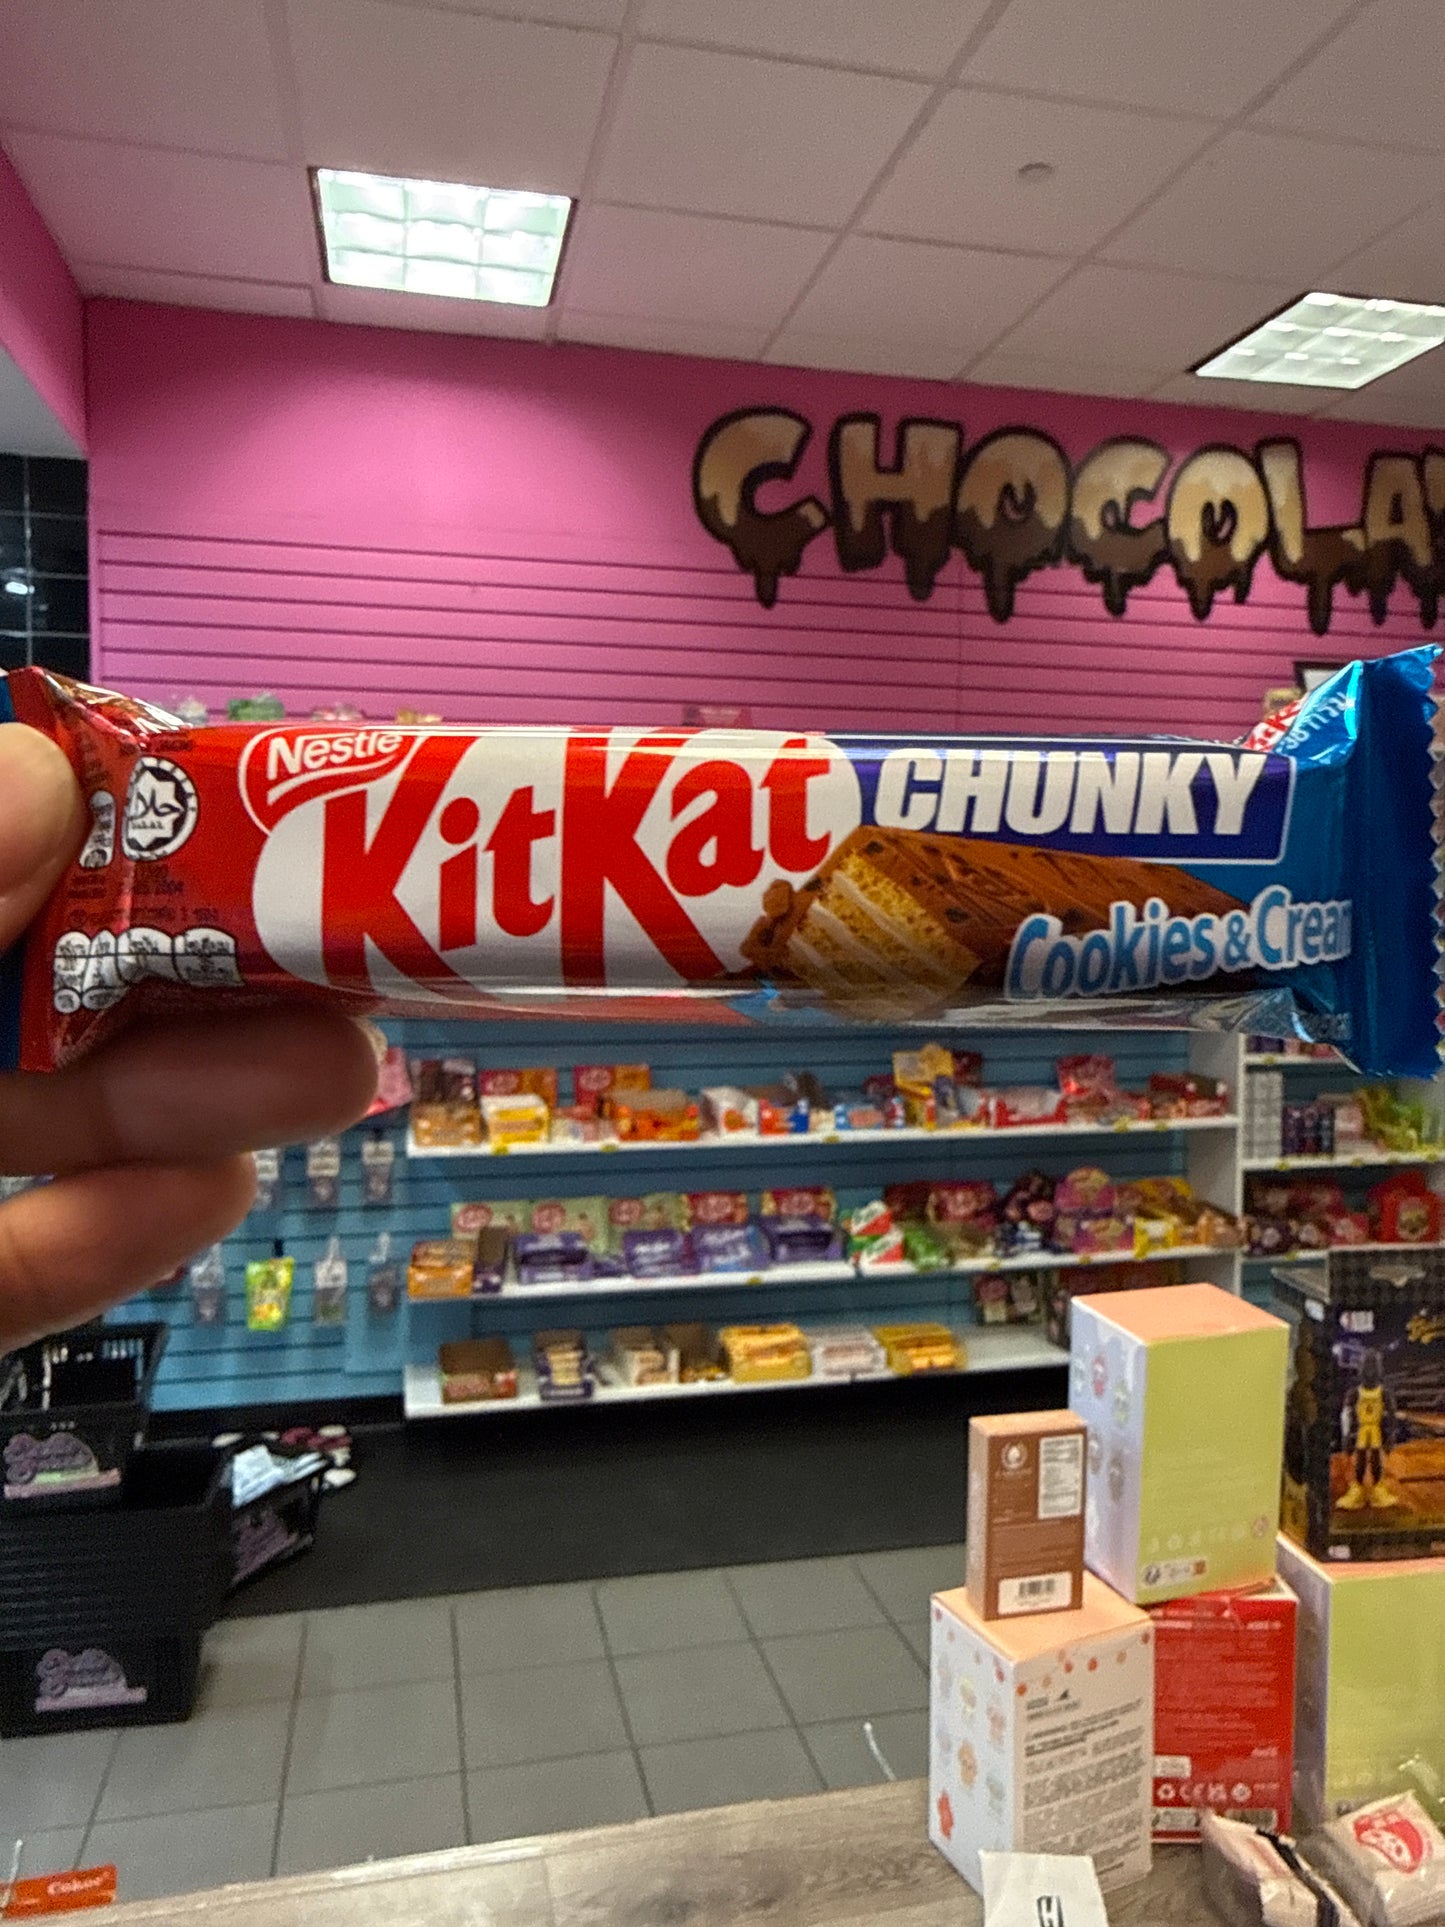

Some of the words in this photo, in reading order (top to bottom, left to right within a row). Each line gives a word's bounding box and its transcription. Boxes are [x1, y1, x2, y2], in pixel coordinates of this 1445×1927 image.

[874, 748, 1268, 837] CHUNKY
[322, 731, 832, 1000] KitKat
[1006, 898, 1218, 999] Cookies
[1223, 909, 1253, 966] &
